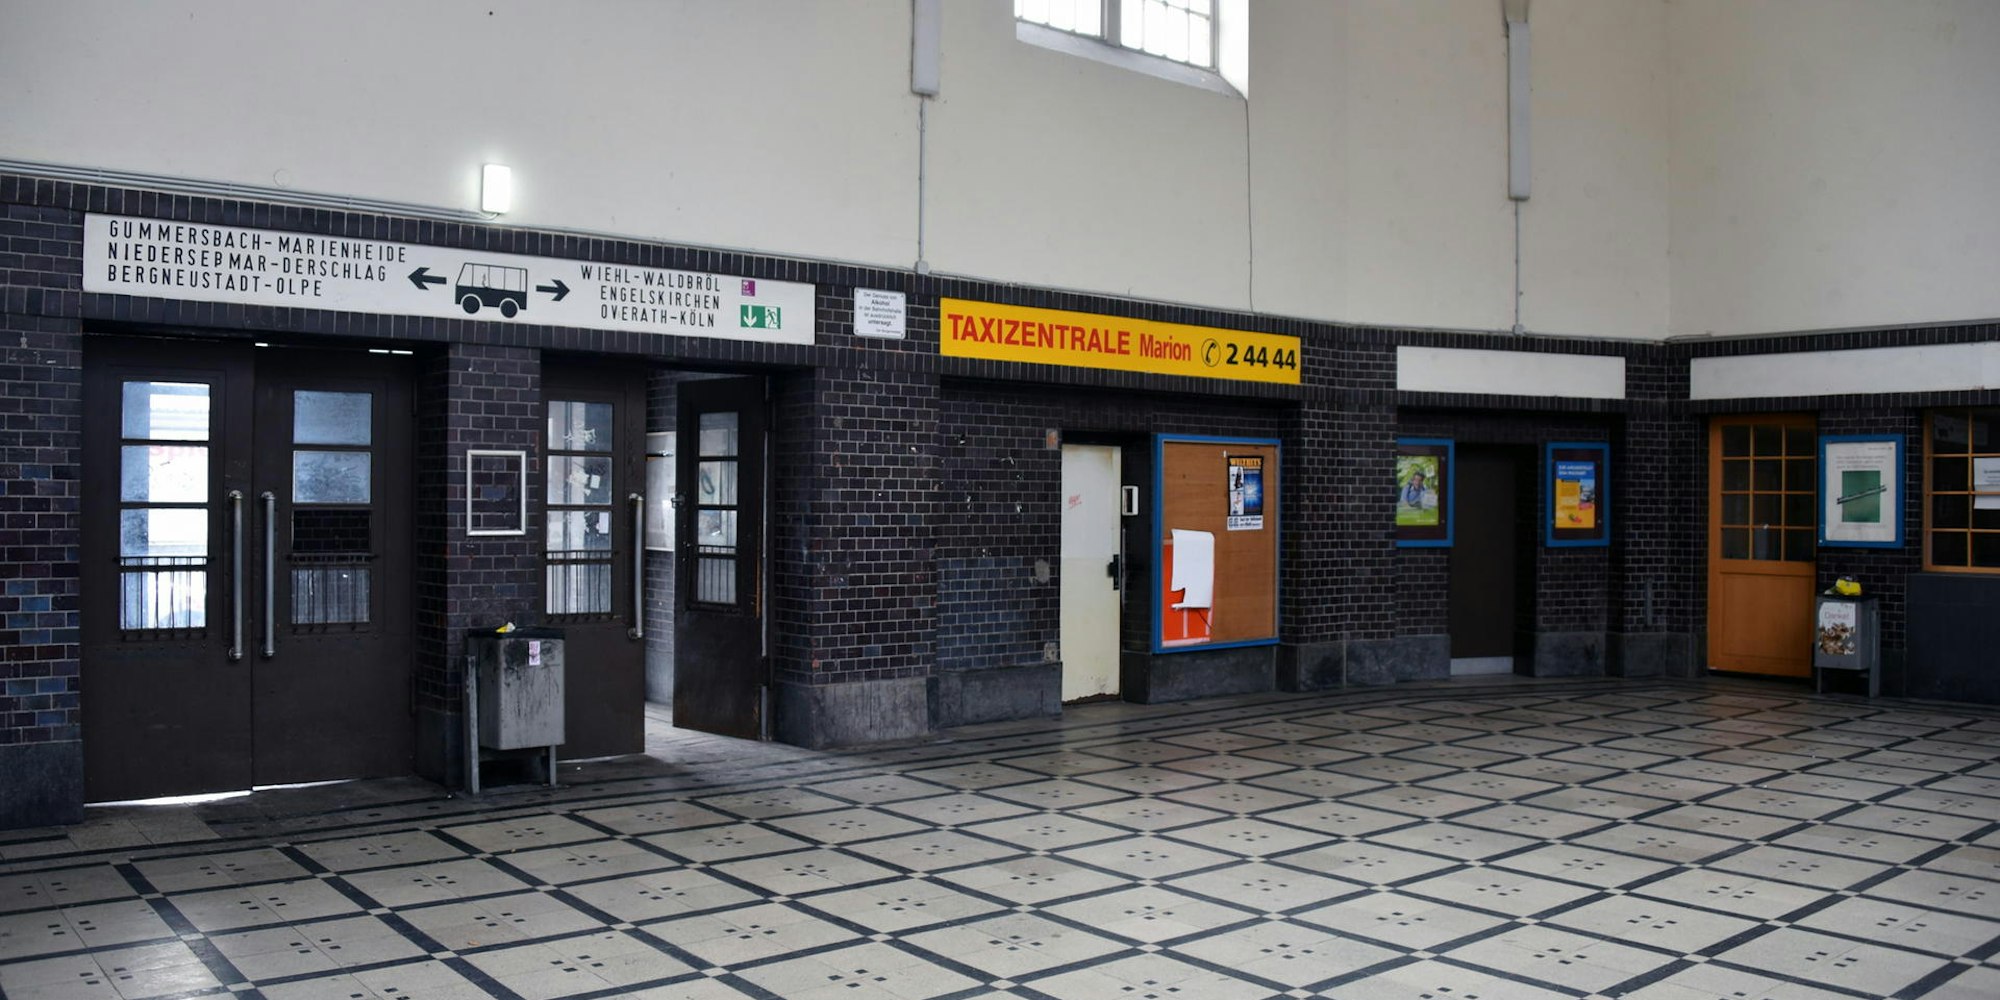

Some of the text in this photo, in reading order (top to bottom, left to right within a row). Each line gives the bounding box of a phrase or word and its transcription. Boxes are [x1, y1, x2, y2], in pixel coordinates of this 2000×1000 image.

[109, 219, 406, 263] GUMMERSBACH-MARIENHEIDE
[107, 264, 322, 297] BERGNEUSTADT-OLPE
[580, 264, 720, 292] WIEHL-WALDBRÖL
[600, 285, 720, 310] ENGELSKIRCHEN
[600, 303, 714, 328] OVERATH-KÖLN
[947, 313, 1297, 370] TAXIZENTRALE Marion 2 44 44
